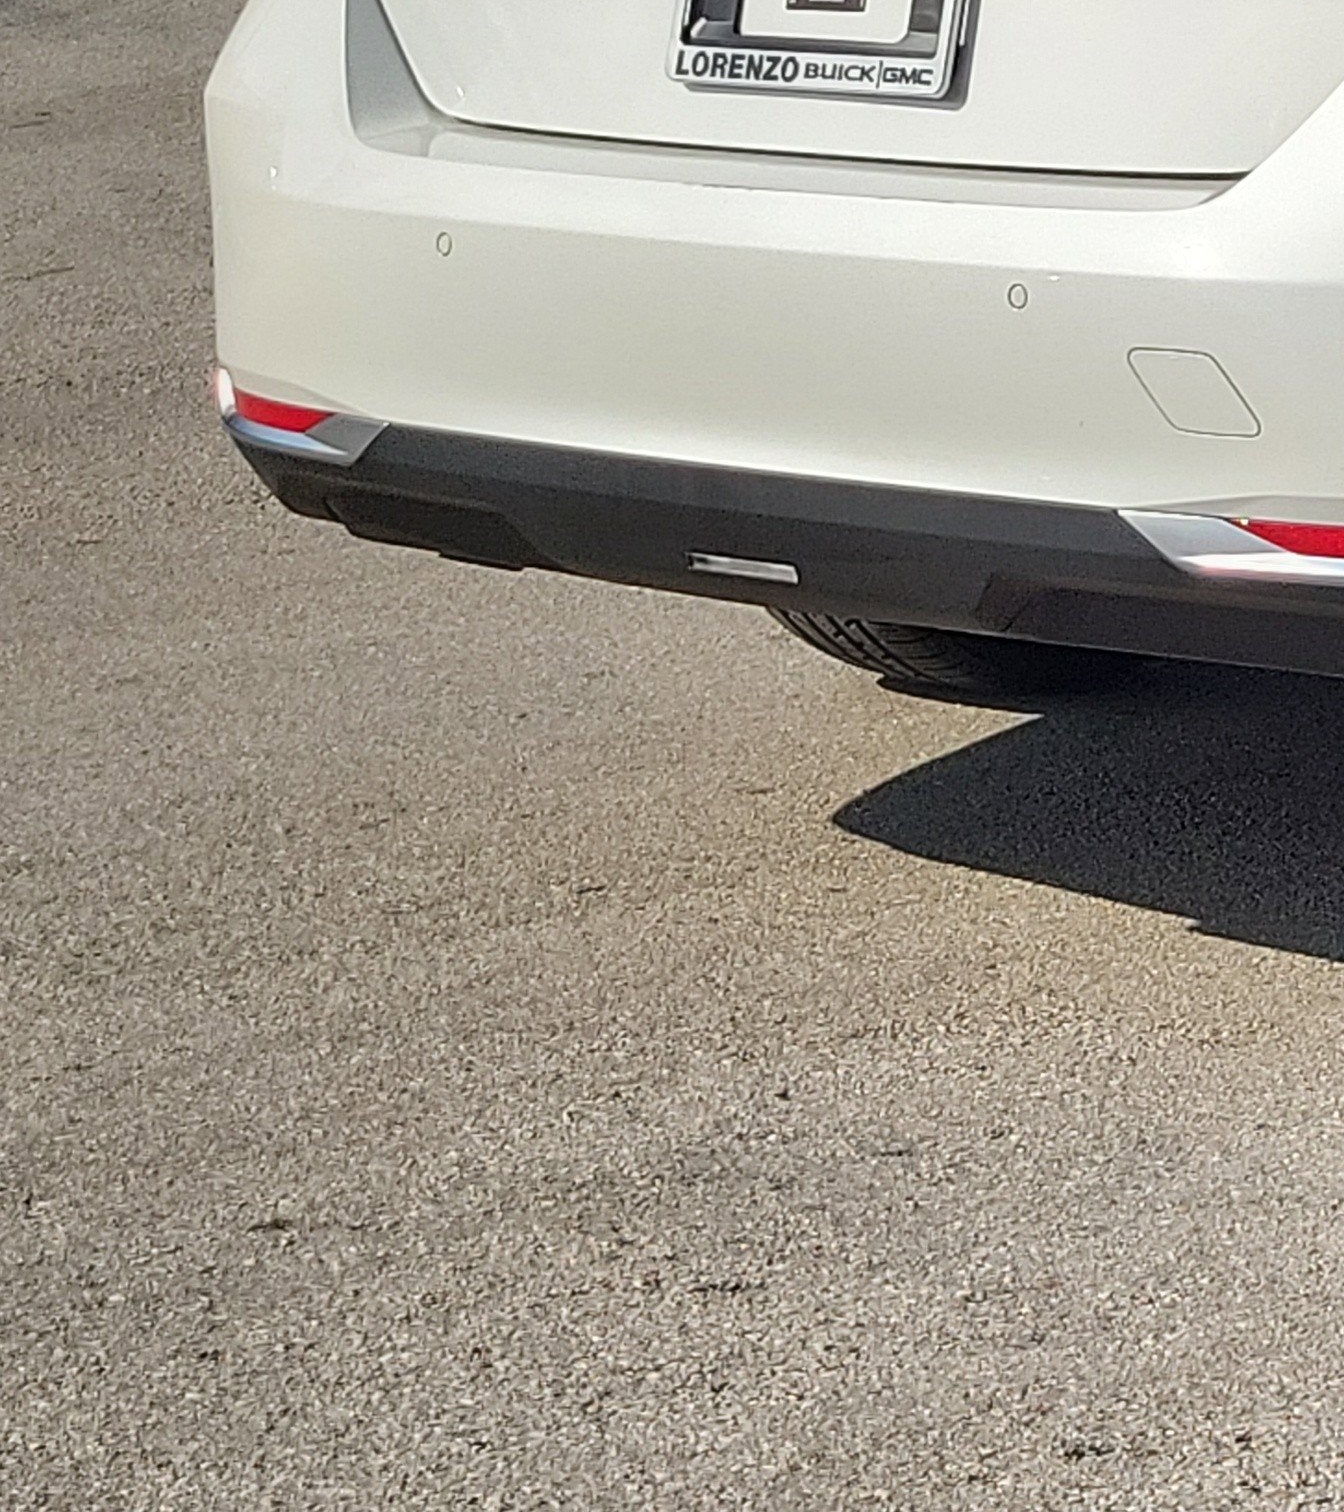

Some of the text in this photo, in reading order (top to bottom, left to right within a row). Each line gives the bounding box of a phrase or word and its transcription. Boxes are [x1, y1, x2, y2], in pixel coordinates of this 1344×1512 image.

[675, 49, 934, 86] LORENZO BUICK GMC
